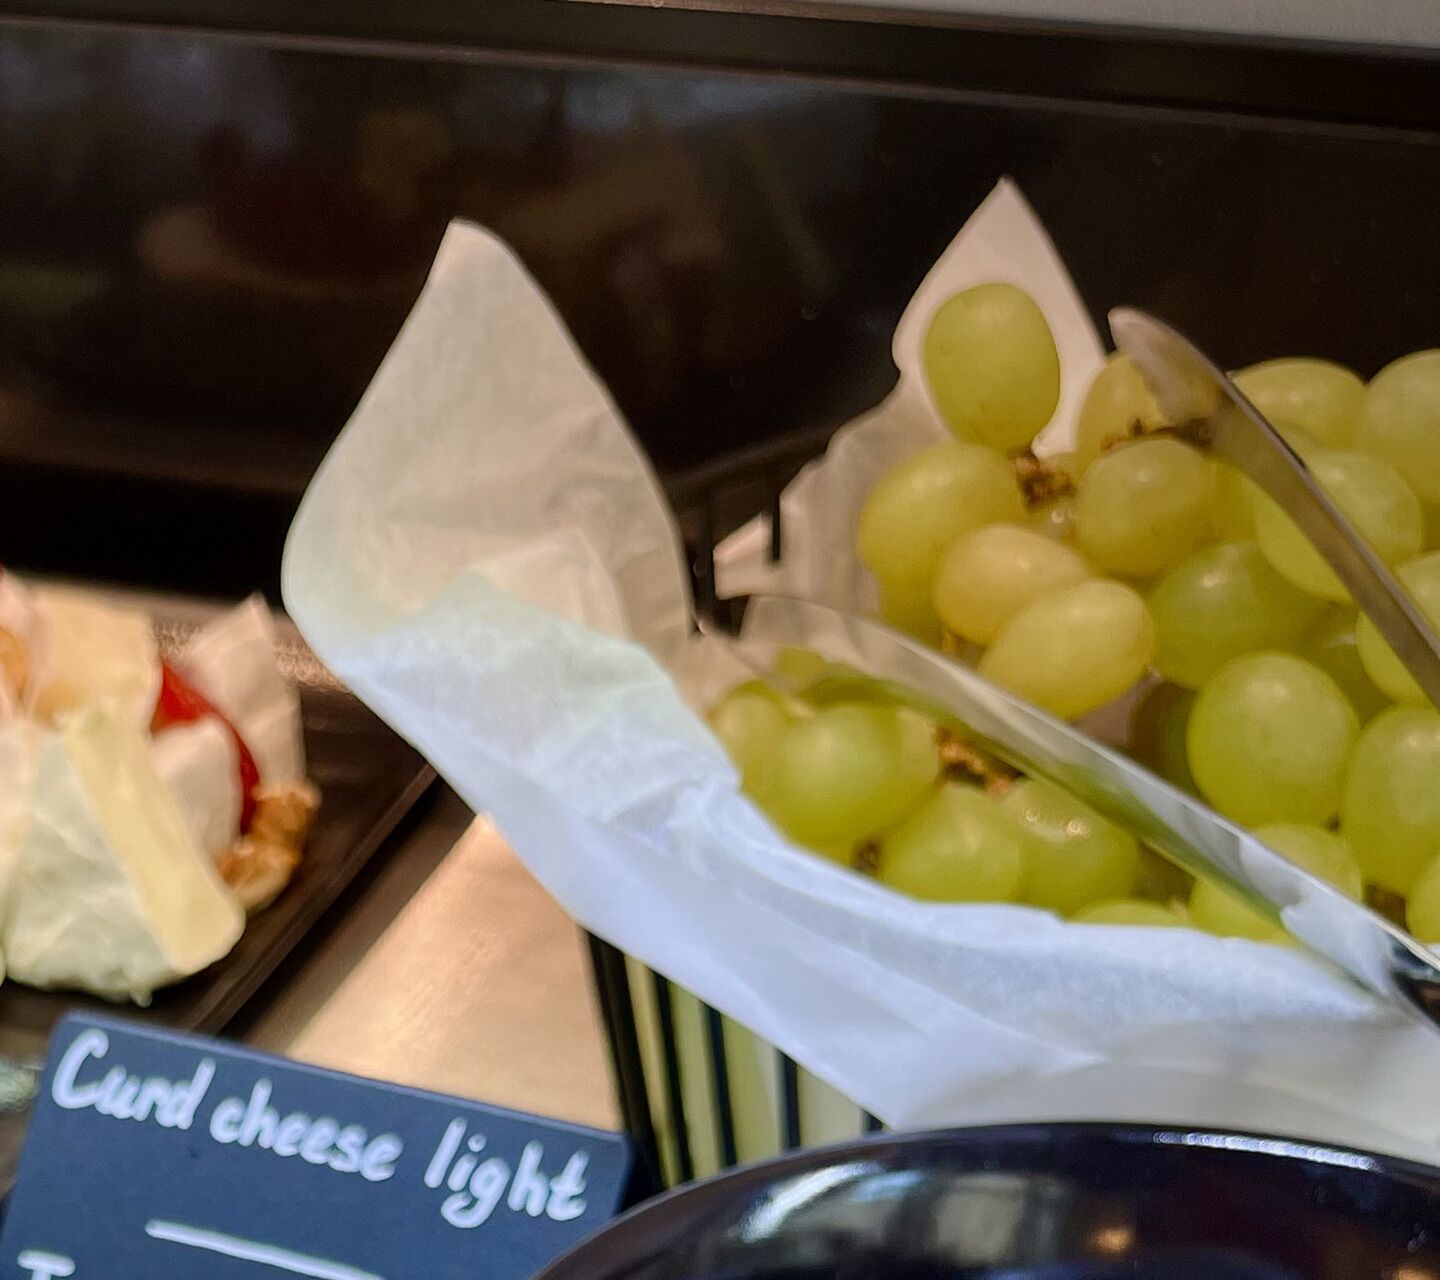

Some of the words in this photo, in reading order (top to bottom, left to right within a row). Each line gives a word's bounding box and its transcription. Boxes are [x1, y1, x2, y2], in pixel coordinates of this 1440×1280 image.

[50, 1028, 216, 1130] Curd
[208, 1079, 404, 1183] cheese
[423, 1117, 588, 1228] light
